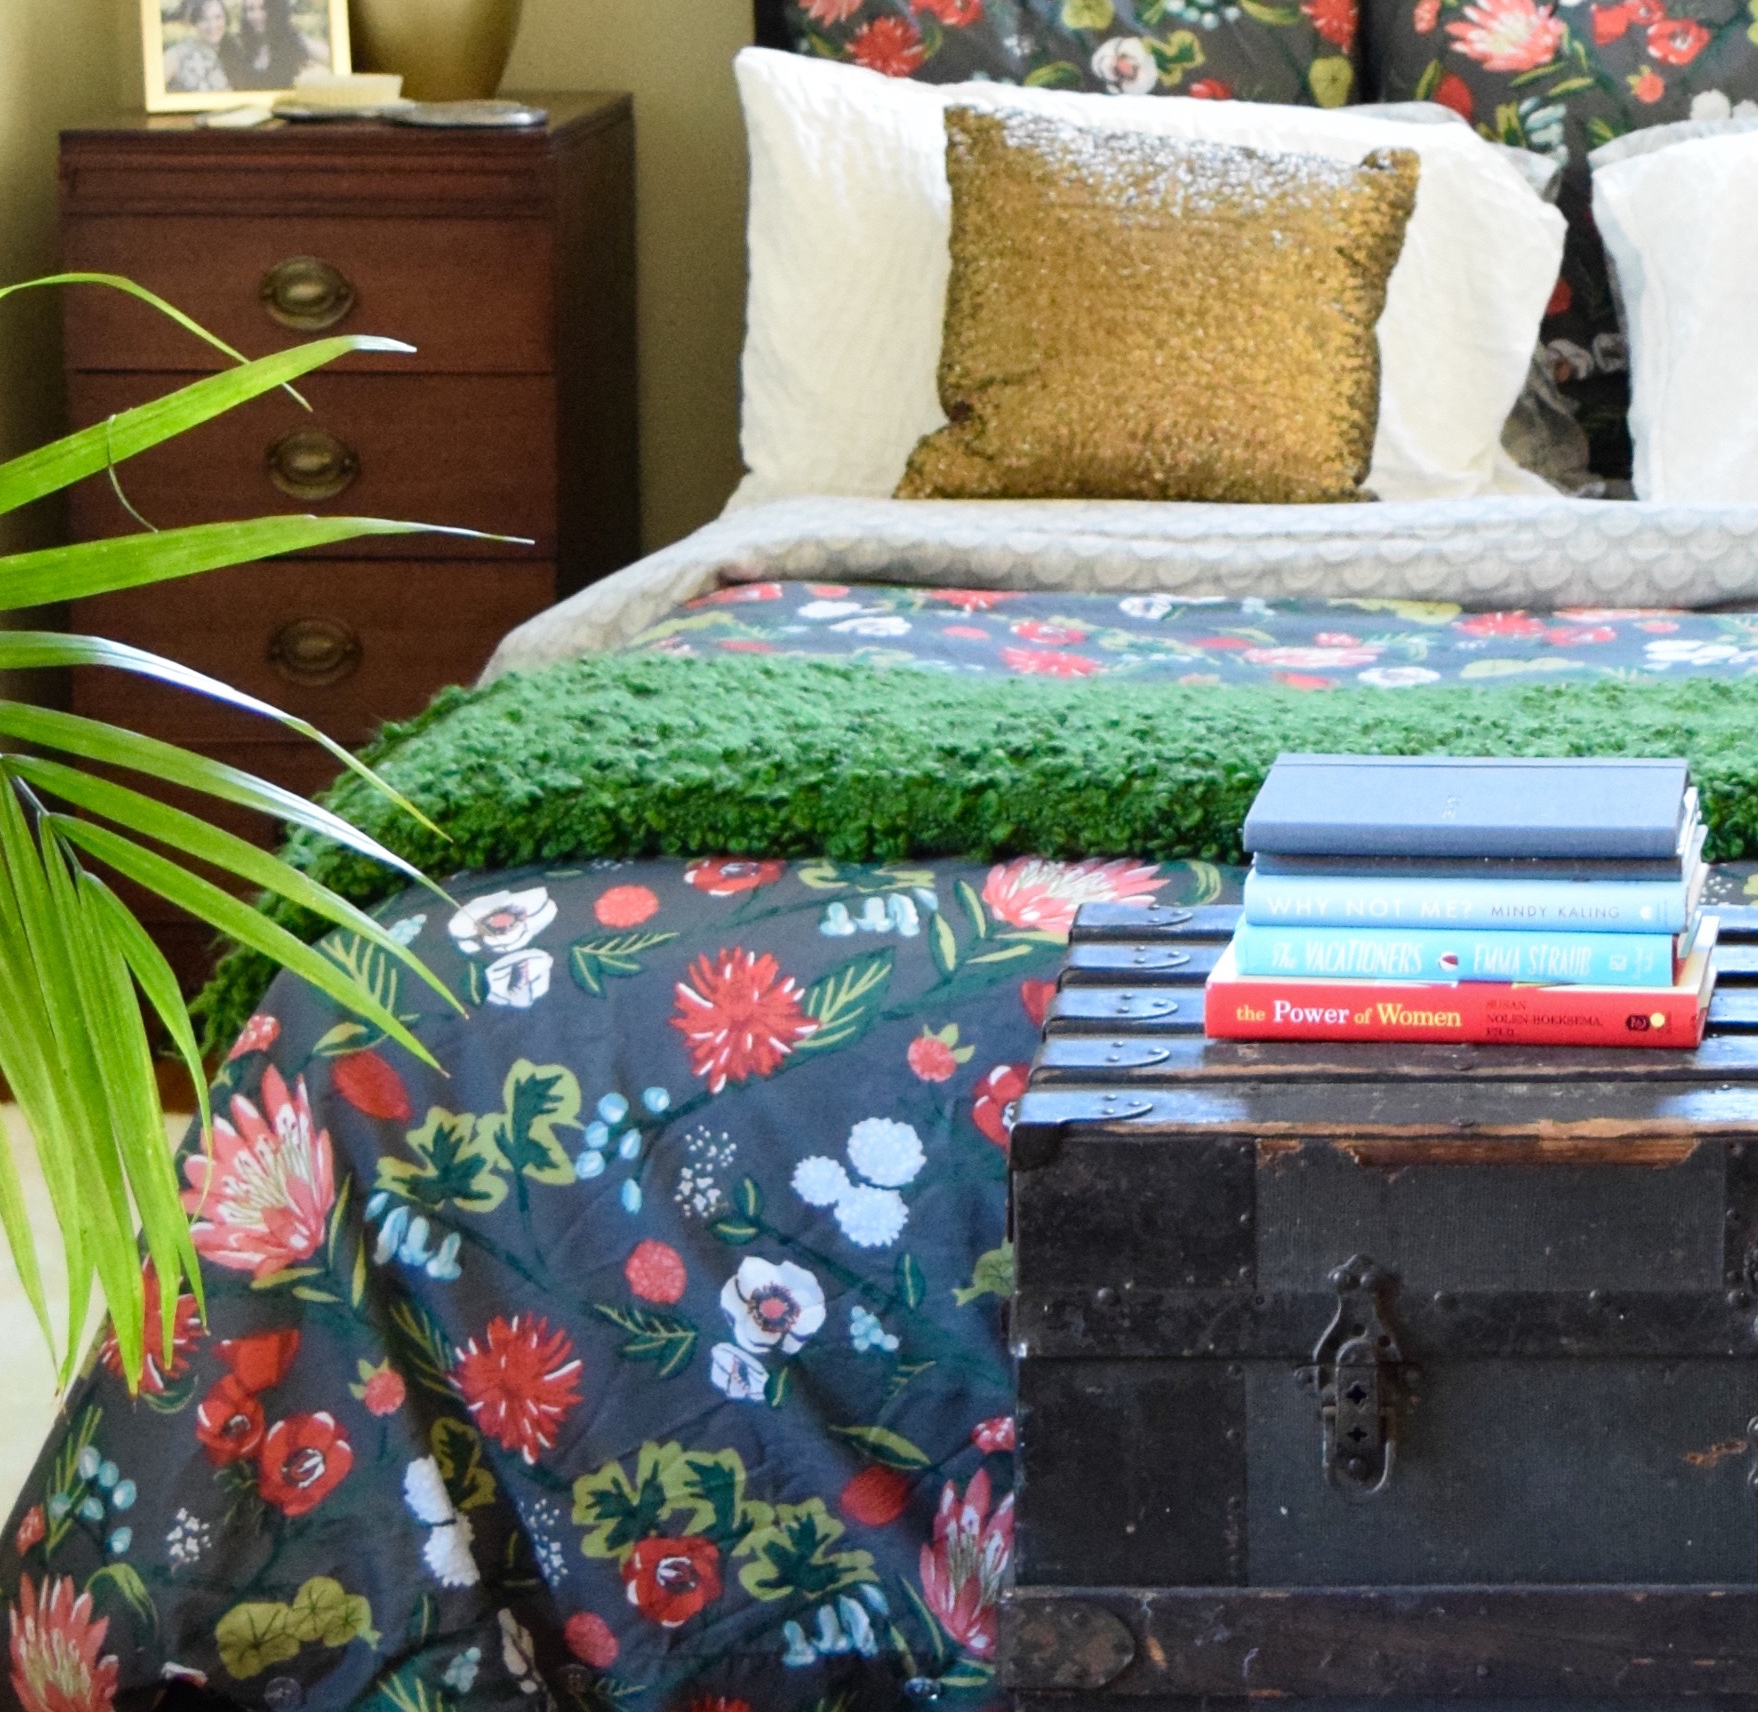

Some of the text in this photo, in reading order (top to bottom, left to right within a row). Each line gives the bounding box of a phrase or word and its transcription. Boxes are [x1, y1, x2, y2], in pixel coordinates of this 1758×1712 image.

[1266, 896, 1473, 918] WHY NOT ME?
[1491, 905, 1620, 919] MINDY KALING
[1304, 939, 1424, 974] VACATIONERS
[1472, 943, 1521, 975] EMMA
[1528, 943, 1592, 977] STRAUB
[1236, 999, 1462, 1027] the Power of Women
